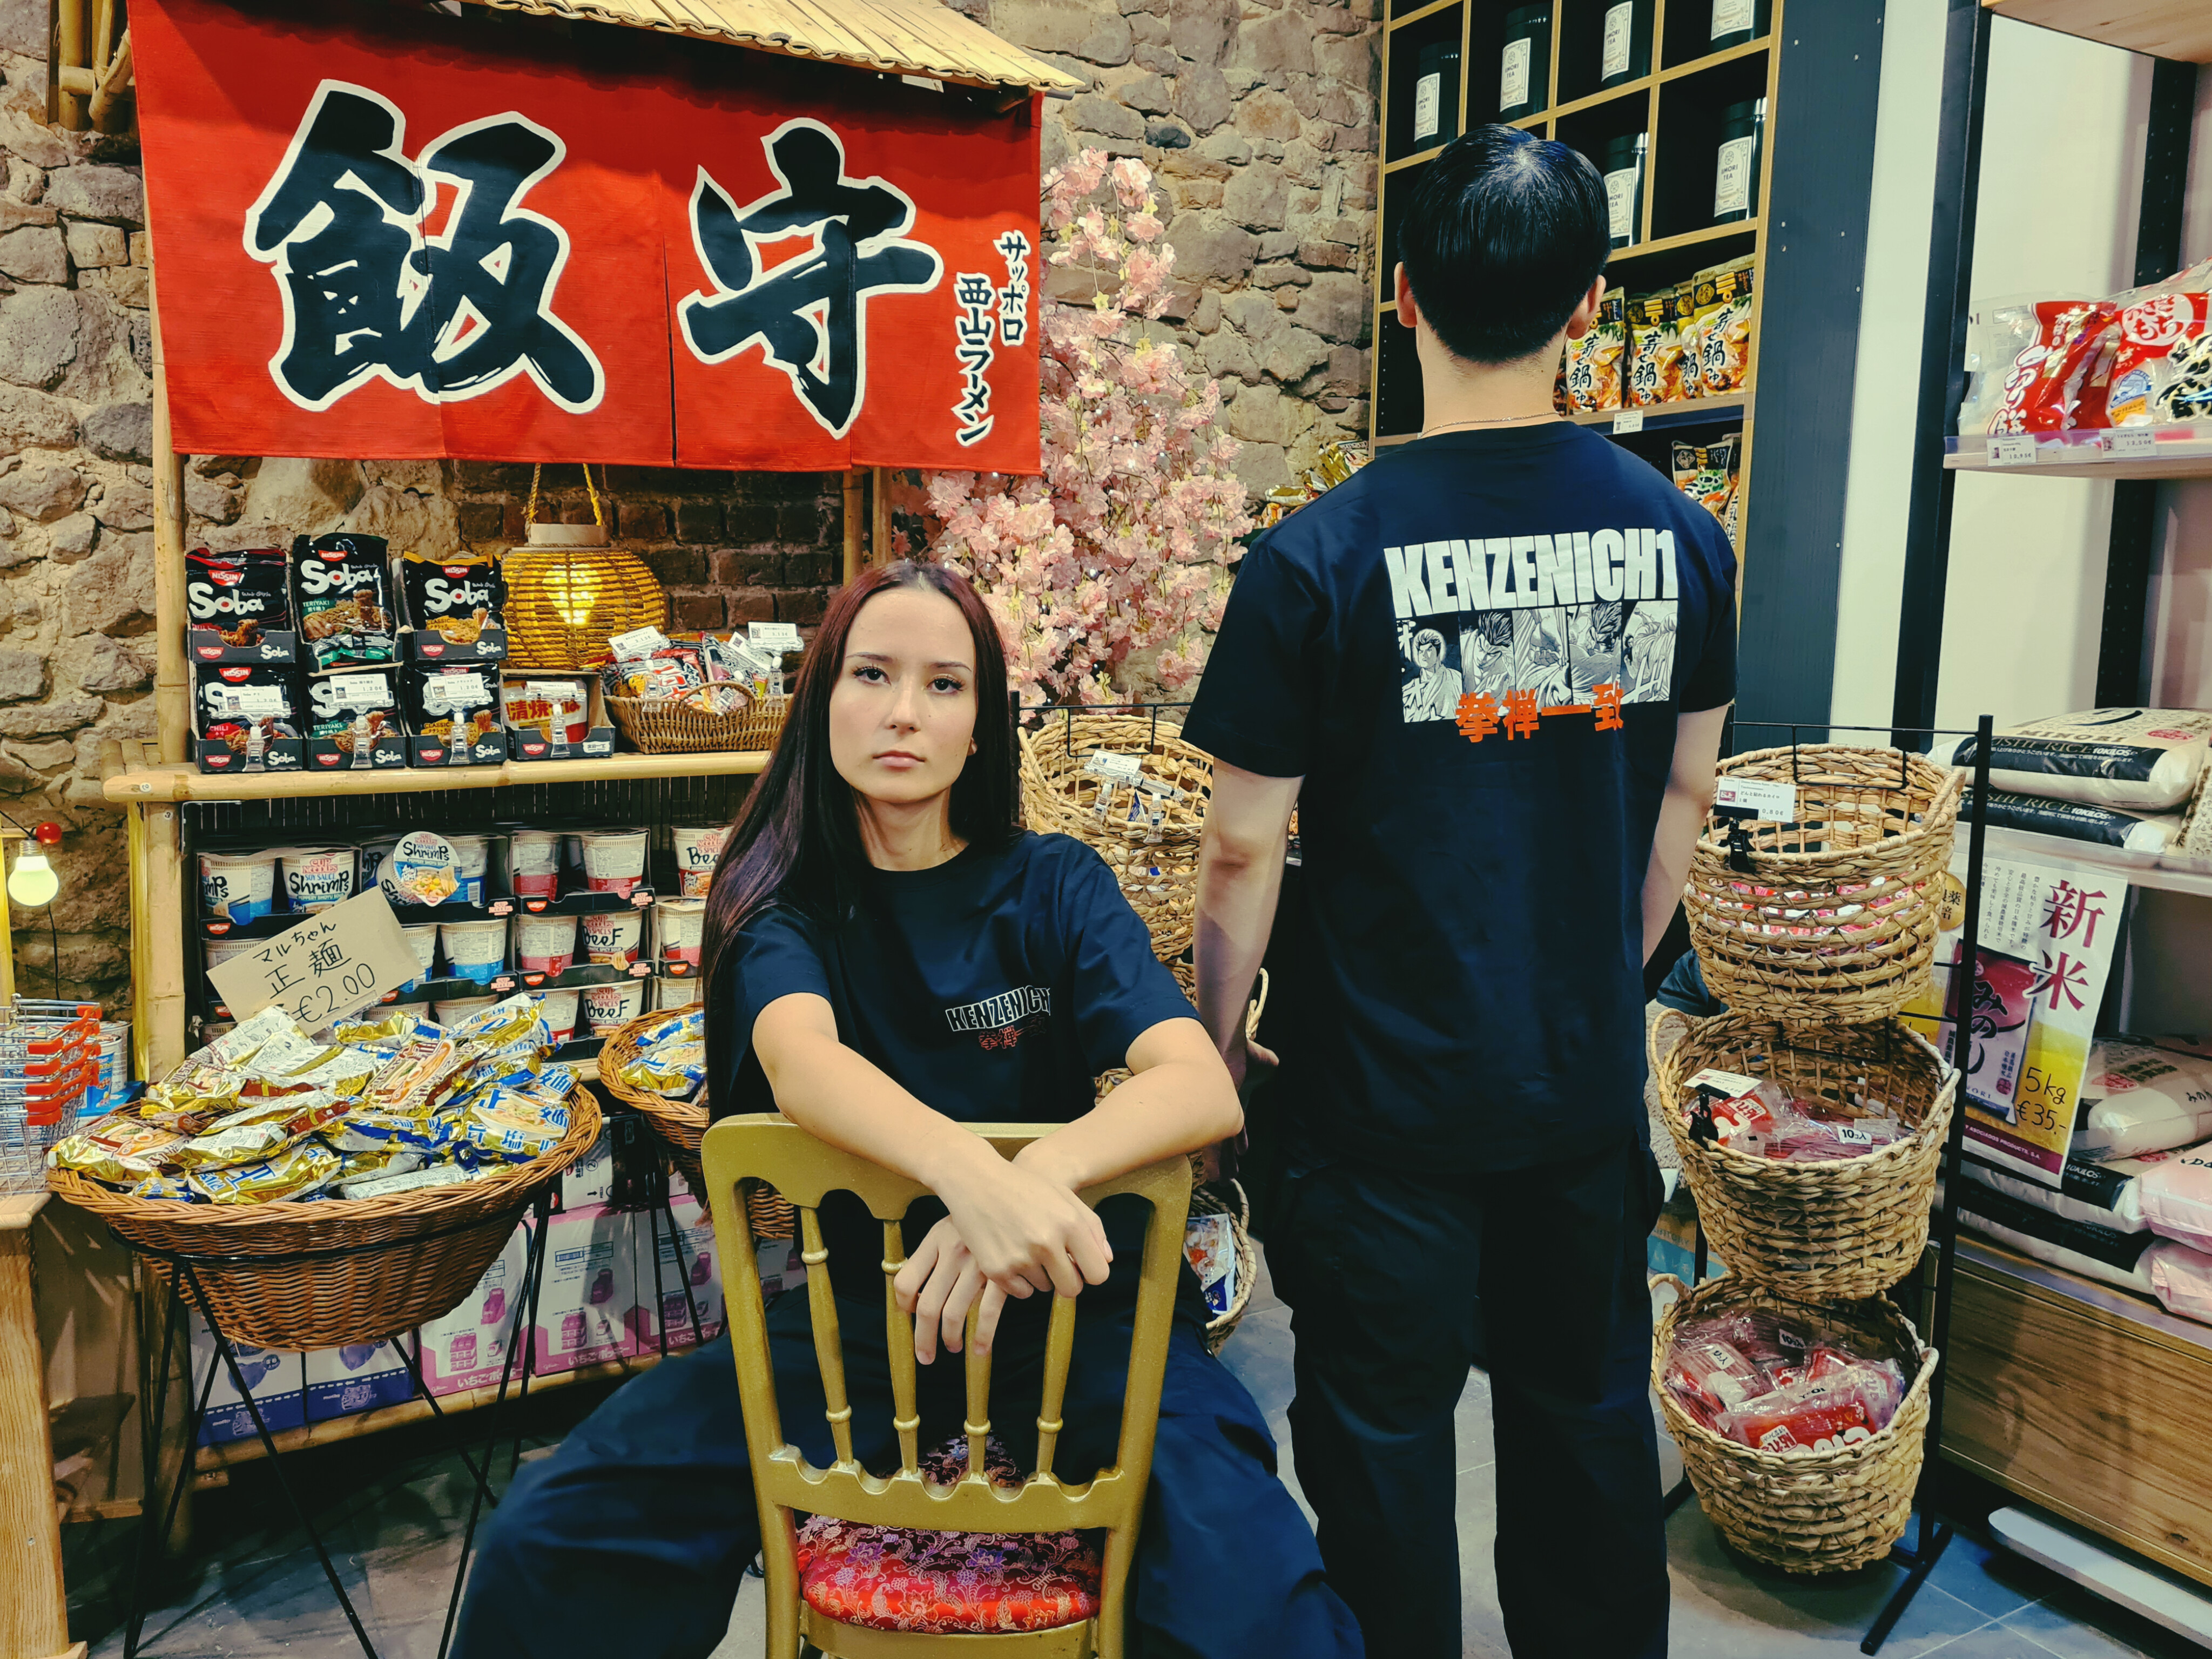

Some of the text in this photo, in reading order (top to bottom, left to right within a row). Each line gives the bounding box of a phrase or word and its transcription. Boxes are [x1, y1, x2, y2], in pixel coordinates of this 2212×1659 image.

[1609, 192, 1623, 201] MORI
[243, 79, 943, 440] 飯守
[994, 230, 1030, 346] サッポロ
[952, 271, 995, 446] 西山ラーメン
[212, 572, 239, 581] NISSIN
[301, 560, 374, 594] Soba
[1384, 528, 1678, 618] KENZENICH1
[188, 582, 265, 619] Soba
[424, 578, 489, 613] Soba
[260, 644, 290, 659] Soba
[476, 641, 502, 655] Soba
[223, 667, 249, 677] NISSIN
[313, 723, 343, 731] TERIYAKI
[2017, 730, 2128, 742] MINORI
[475, 744, 501, 758] Soba
[2044, 741, 2093, 753] RICE
[268, 751, 296, 766] Soba
[375, 749, 402, 764] Soba
[2025, 798, 2073, 813] RICE
[302, 865, 338, 874] NOODLES
[253, 921, 336, 962] マルちゃん
[2039, 879, 2108, 1012] 新米
[292, 963, 375, 1023] €2.00
[945, 985, 1051, 1032] KENZENICH
[2025, 1067, 2067, 1105] 5kg
